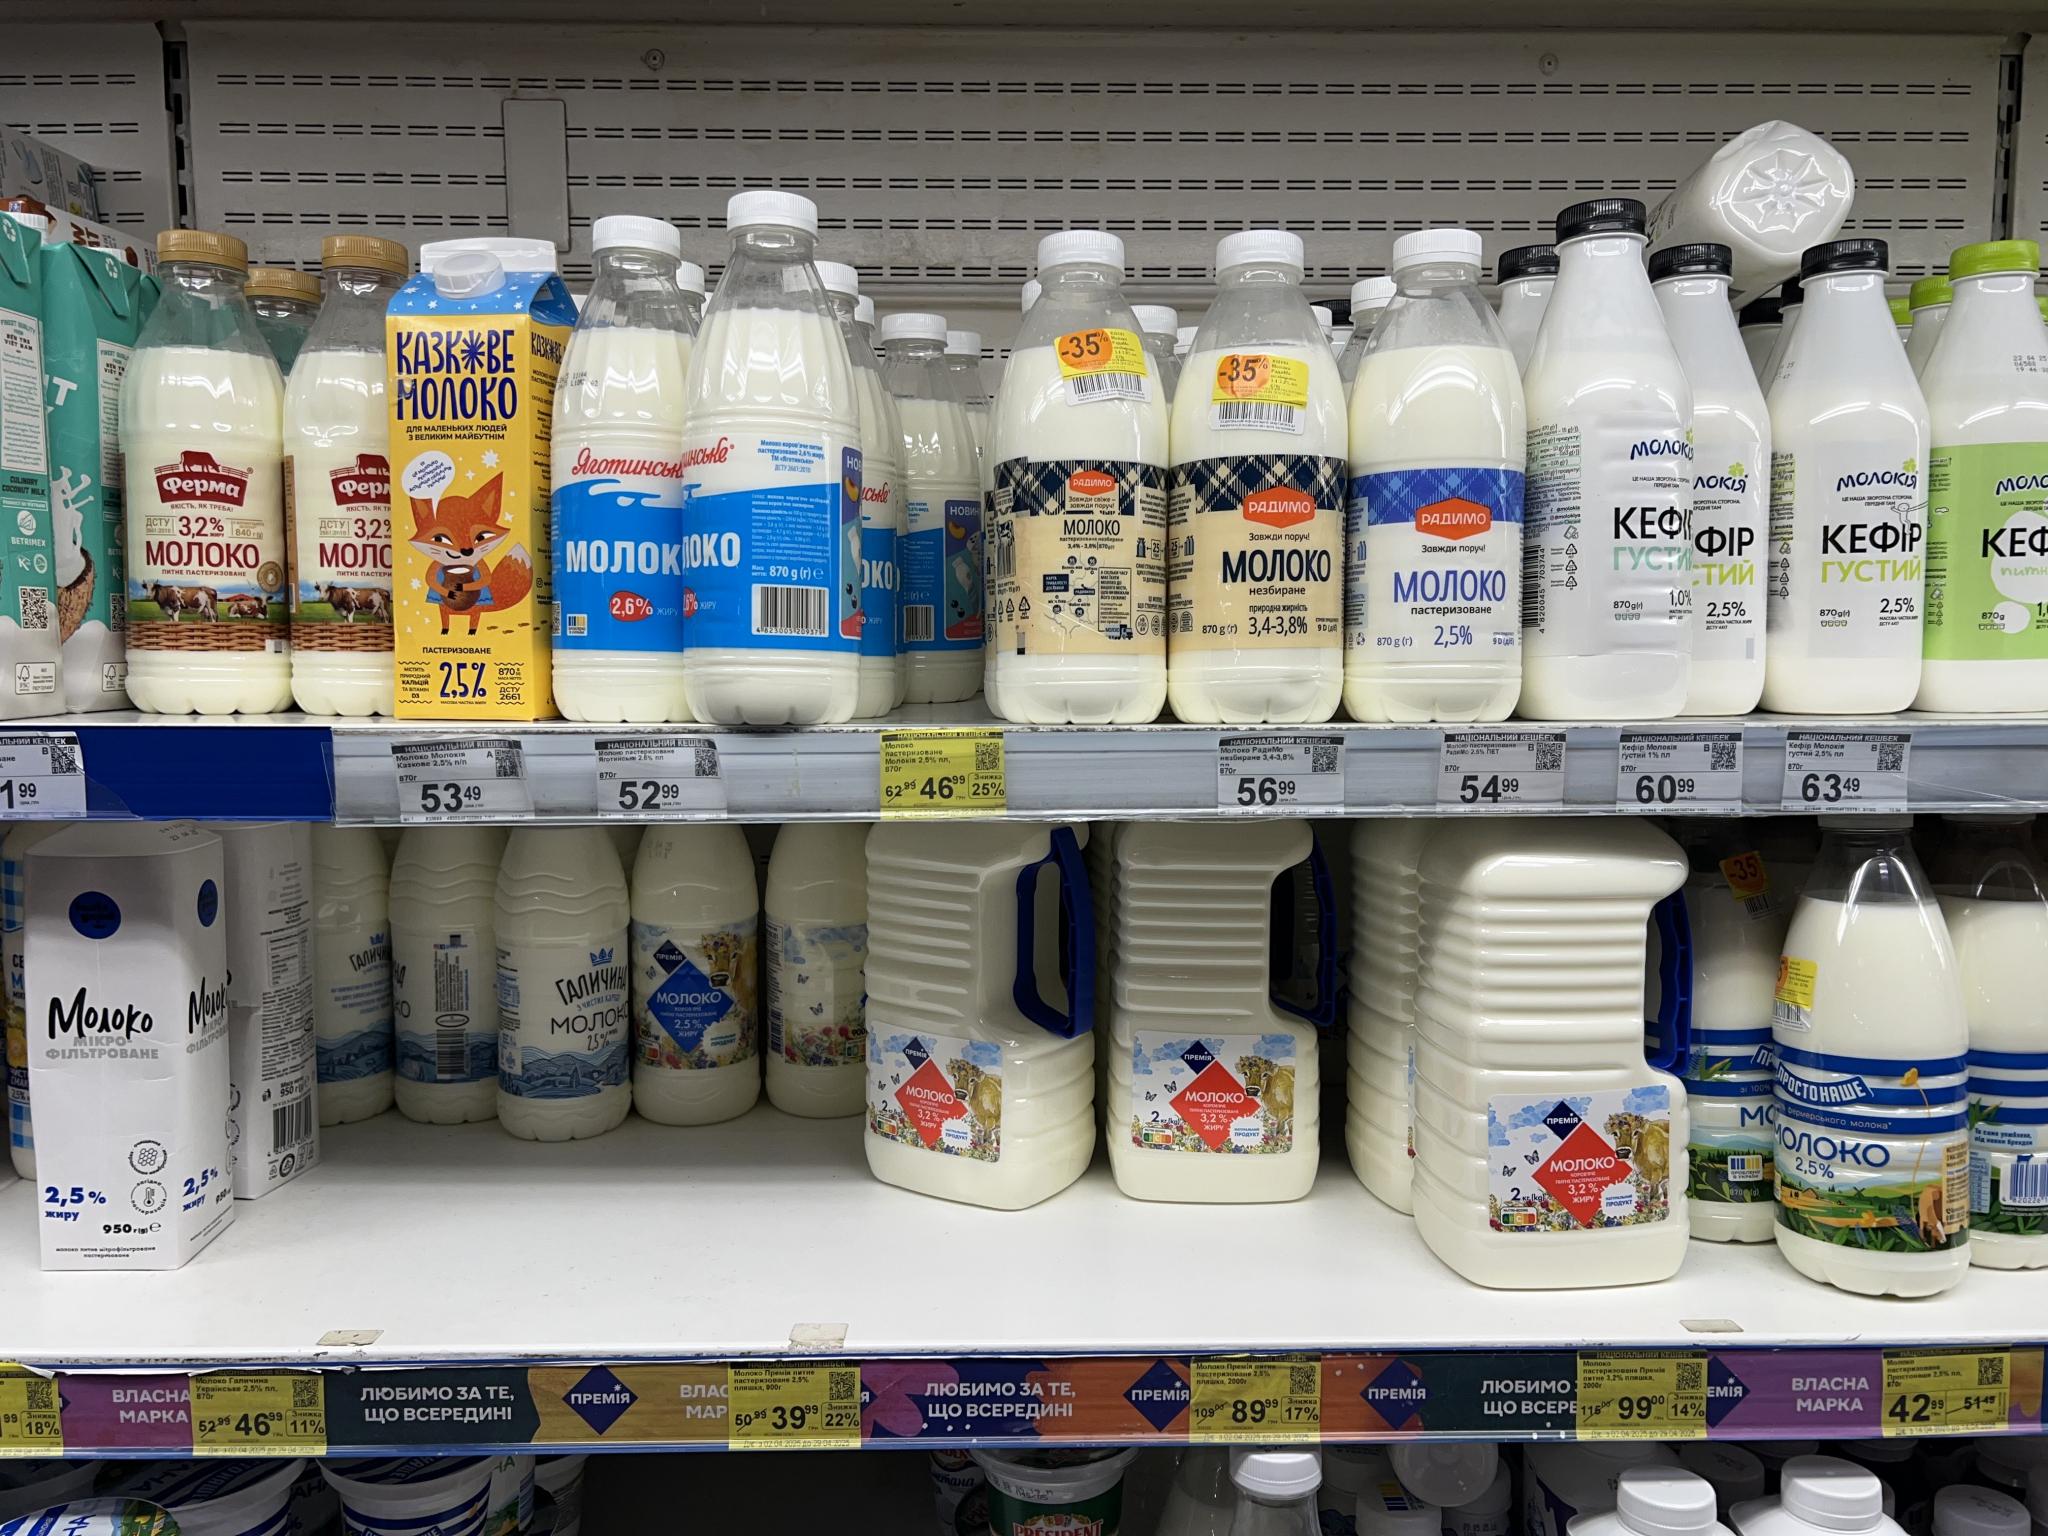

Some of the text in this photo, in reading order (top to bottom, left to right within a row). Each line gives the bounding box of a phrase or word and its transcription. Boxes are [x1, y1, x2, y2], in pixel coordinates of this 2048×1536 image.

[397, 376, 518, 421] МОЛОКО
[406, 424, 507, 434] ДЛЯ МАЛЕНЬКИХ ЛЮДЕЙ
[455, 432, 505, 440] МАЙБУТНІМ
[162, 477, 240, 498] Ферма
[1072, 477, 1113, 488] РАДИМО
[1248, 501, 1311, 514] РАДИМО
[145, 518, 170, 527] ДСТУ
[319, 520, 345, 529] ДСТУ
[1421, 513, 1486, 525] РАДИМО
[235, 528, 252, 537] 840
[1063, 519, 1121, 536] МОЛОКО
[11, 536, 46, 547] BETRIMEX
[1249, 532, 1310, 542] Завжди поруч!
[1822, 522, 1922, 554] КЕФІР
[146, 541, 260, 569] МОЛОКО
[1421, 544, 1486, 554] Завжди поруч!
[1222, 549, 1331, 583] МОЛОКО
[1821, 556, 1921, 583] ГУСТИЙ
[1249, 585, 1306, 597] незбиране
[1393, 570, 1506, 603] МОЛОКО
[611, 597, 653, 616] 2,6%
[1249, 604, 1281, 613] природна
[1411, 606, 1491, 616] пастеризоване
[1706, 602, 1746, 618] 2,5%
[1880, 597, 1915, 614] 2,5%
[1202, 624, 1218, 634] 870
[1376, 637, 1393, 646] 870
[1434, 625, 1473, 648] 2,5%
[422, 647, 492, 655] ПАСТЕРИЗОВАНЕ
[498, 667, 515, 676] 870
[439, 661, 487, 698] 2,5%
[1230, 737, 1295, 745] НАЦІОНАЛЬНИЙ
[1631, 734, 1695, 742] НАЦІОНАЛЬНИЙ
[1864, 734, 1899, 742] КЕШБЕК
[1788, 742, 1812, 750] Кефір
[1621, 751, 1646, 759] густий
[1788, 750, 1813, 758] густий
[885, 775, 966, 799] 62 99 46 99
[972, 782, 1005, 796] 25%
[1237, 777, 1296, 806] 56 99
[1460, 775, 1519, 803] 54 99
[1636, 775, 1695, 804] 60 99
[1801, 773, 1860, 802] 63 49
[421, 783, 482, 813] 53 49
[618, 780, 680, 810] 52 99
[656, 952, 683, 962] ПРЕМІЯ
[656, 991, 722, 1005] МОЛОКО
[48, 987, 154, 1040] Молоко
[73, 1035, 132, 1047] МІКРО-
[45, 1047, 159, 1060] ФІЛЬТРОВАНЕ
[1776, 1066, 1866, 1103] ПРОСТОНАШЕ
[906, 1085, 954, 1105] МОЛОКО
[1185, 1090, 1245, 1104] МОЛОКО
[1547, 1116, 1579, 1125] ПРЕМІЯ
[1550, 1156, 1615, 1173] МОЛОКО
[1795, 1157, 1834, 1179] 2,5%
[1572, 1195, 1595, 1203] ЖИРУ
[1605, 1199, 1633, 1208] ПРОДУКТ
[45, 1210, 80, 1221] жиру
[103, 1224, 132, 1234] 950
[924, 1382, 1076, 1398] ЛЮБИМО ЗА ТЕ,
[1480, 1379, 1572, 1394] ЛЮБИМО
[1791, 1377, 1870, 1391] ВЛАСНА
[112, 1389, 190, 1403] ВЛАСНА
[360, 1386, 515, 1402] ЛЮБИМО ЗА ТЕ,
[570, 1392, 631, 1405] ПРЕМІЯ
[1131, 1388, 1190, 1401] ПРЕМІЯ
[1368, 1387, 1426, 1400] ПРЕМІЯ
[1673, 1393, 1704, 1401] Знижка
[827, 1403, 858, 1411] Знижка
[1287, 1397, 1318, 1405] Знижка
[1618, 1395, 1665, 1420] 99 00
[1796, 1398, 1864, 1412] МАРКА
[1888, 1393, 1944, 1423] 42 99
[364, 1406, 512, 1423] ЩО ВСЕРЕДИНІ
[928, 1403, 1073, 1419] ЩО ВСЕРЕДИНІ
[1232, 1398, 1279, 1423] 89 99
[1285, 1406, 1319, 1421] 17%
[1484, 1401, 1512, 1417] ЩО
[1671, 1402, 1705, 1417] 14%
[120, 1410, 189, 1424] МАРКА
[198, 1411, 283, 1436] 52 99 46 99
[735, 1404, 819, 1430] 50 99 39 99
[824, 1413, 860, 1428] 22%
[25, 1421, 60, 1436] 18%
[290, 1419, 325, 1434] 11%
